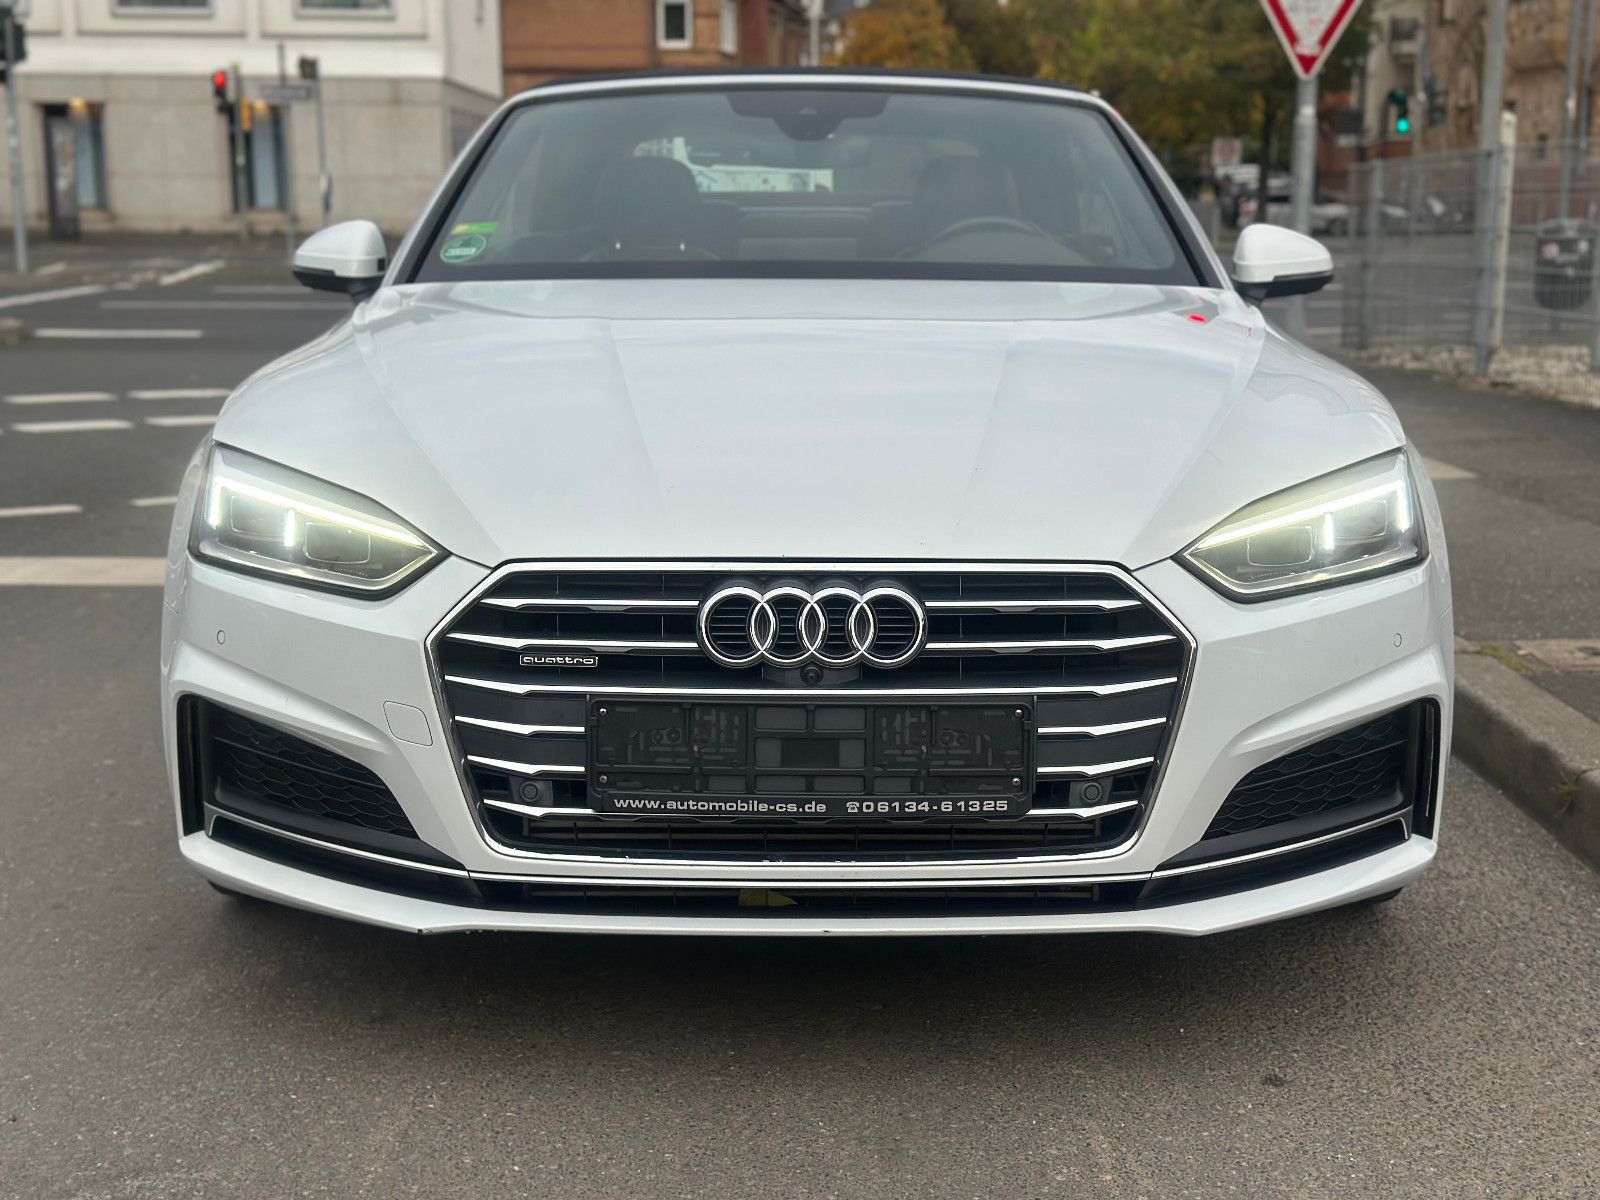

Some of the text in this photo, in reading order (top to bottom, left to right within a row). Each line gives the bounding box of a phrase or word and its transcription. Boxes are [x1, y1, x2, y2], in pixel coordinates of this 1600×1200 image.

[522, 656, 594, 665] quattro
[613, 798, 1008, 813] www.automobile-cs.de 06134-61325
